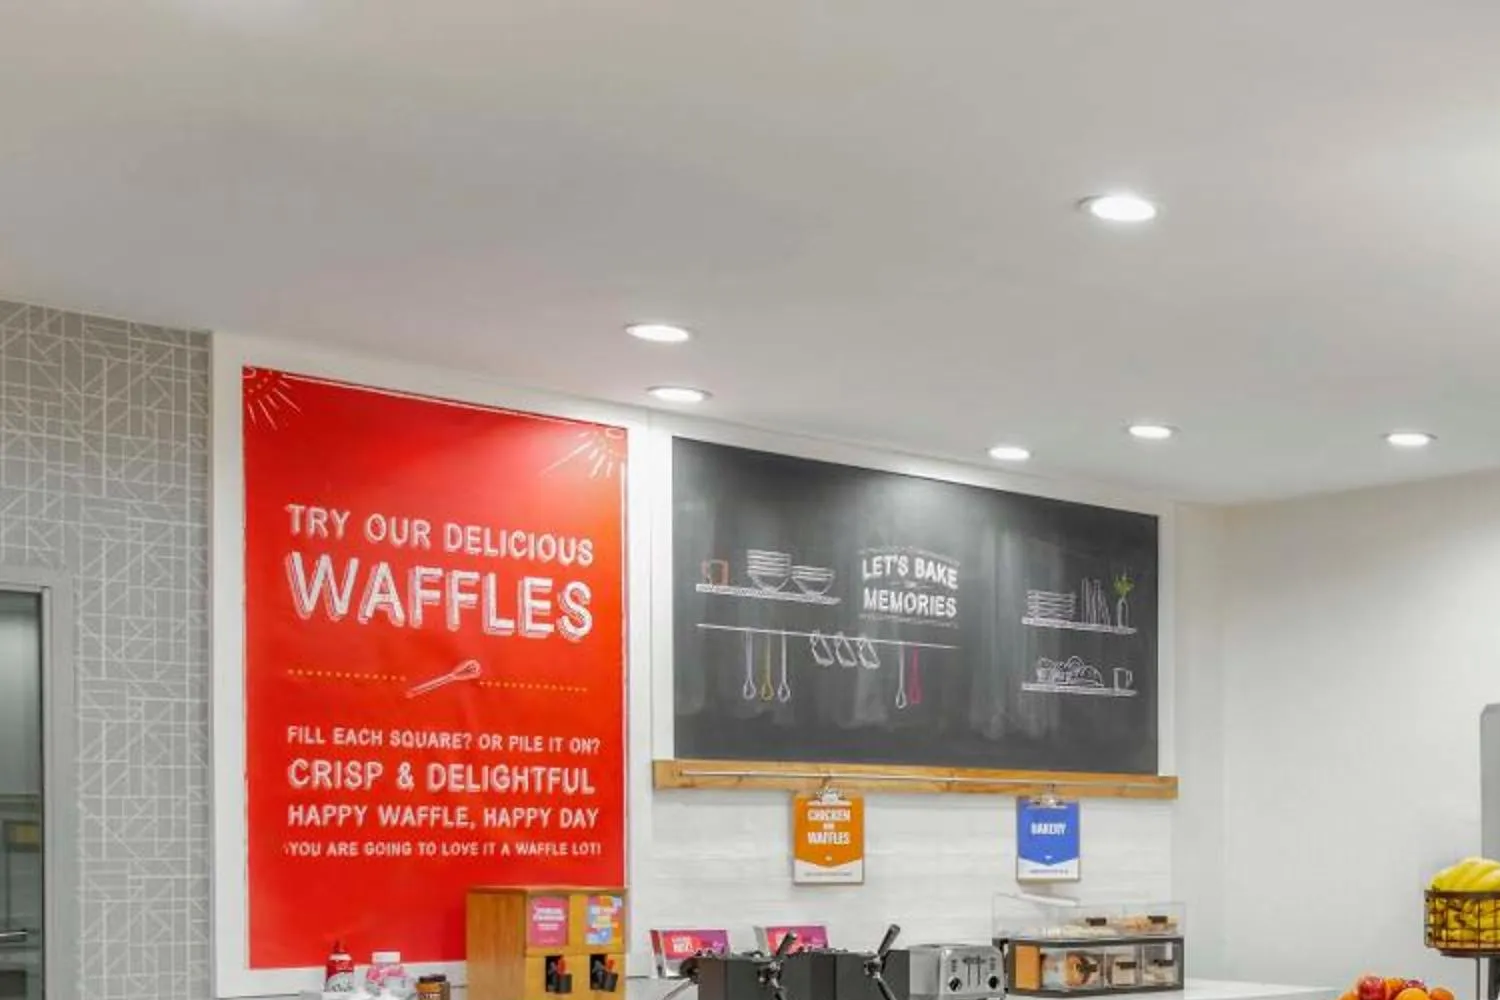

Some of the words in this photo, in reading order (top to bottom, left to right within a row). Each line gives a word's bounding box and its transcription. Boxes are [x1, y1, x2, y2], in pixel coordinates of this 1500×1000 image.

[285, 503, 350, 539] TRY
[365, 512, 431, 549] OUR
[444, 524, 594, 565] DELICIOUS
[862, 555, 909, 580] LET'S
[915, 557, 958, 590] BAKE
[285, 550, 594, 643] WAFFLES
[863, 587, 957, 618] MEMORIES
[287, 725, 326, 745] FILL
[333, 727, 383, 746] EACH
[389, 730, 472, 749] SQUARE?
[479, 733, 503, 750] OR
[509, 735, 543, 752] PILE
[549, 736, 563, 753] IT
[570, 737, 601, 755] ON?
[288, 758, 384, 791] CRISP
[396, 761, 415, 792] &
[427, 761, 595, 795] DELIGHTFUL
[287, 804, 368, 827] HAPPY
[378, 805, 476, 830] WAFFLE,
[483, 807, 551, 829] HAPPY
[559, 807, 599, 829] DAY
[326, 841, 359, 857] ARE
[364, 841, 411, 856] GOING
[418, 841, 436, 856] TO
[441, 841, 479, 856] LOVE
[483, 842, 496, 856] IT
[501, 842, 511, 856] A
[516, 842, 568, 856] WAFFLE
